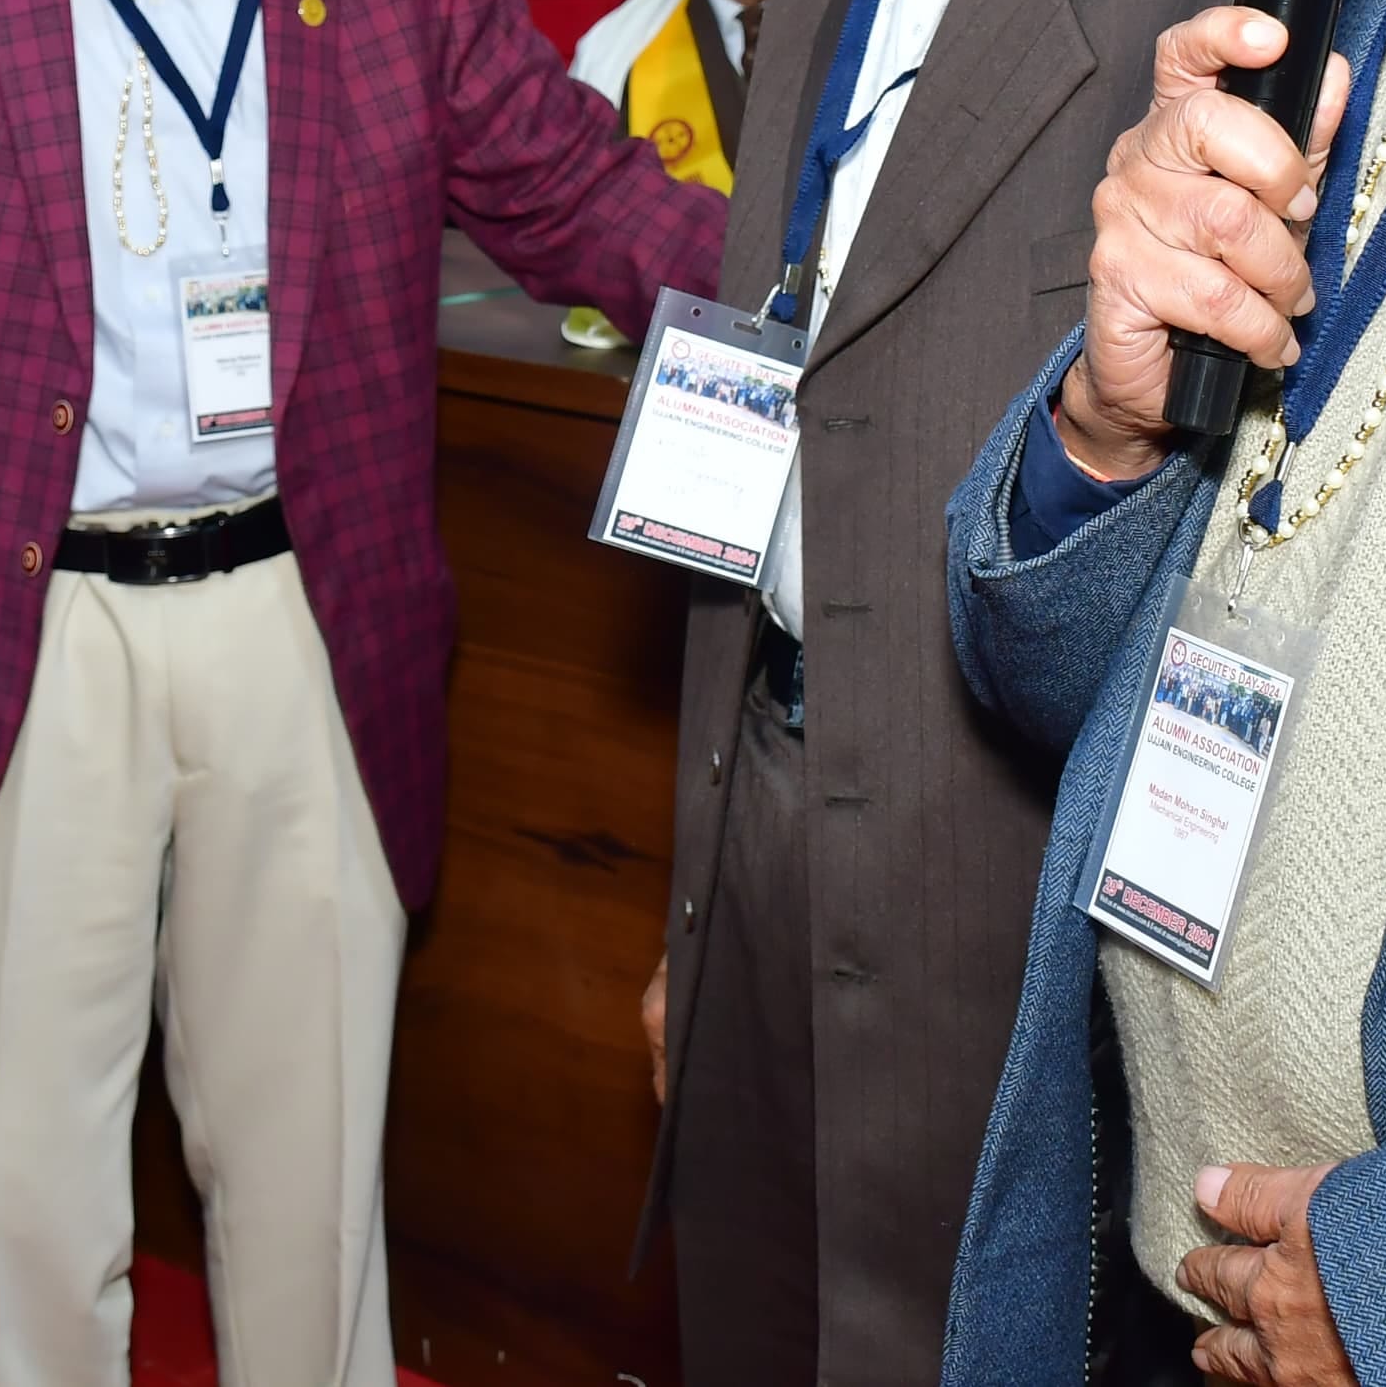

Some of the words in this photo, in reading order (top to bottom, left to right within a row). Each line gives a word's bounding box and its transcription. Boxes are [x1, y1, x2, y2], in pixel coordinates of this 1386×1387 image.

[656, 395, 704, 415] ALUMNI
[707, 410, 788, 443] ASSOCIATION
[1190, 651, 1237, 681] GECUITE'S
[1238, 671, 1281, 698] DAY-2024
[1147, 732, 1172, 752] UJJAIN
[1173, 744, 1221, 775] ENGINEERING
[1222, 767, 1256, 792] COLLEGE
[1152, 715, 1191, 744] ALUMNI
[1191, 733, 1261, 776] ASSOCIATION
[1148, 782, 1173, 803] Madan
[1175, 794, 1199, 816] Mohan
[1200, 808, 1230, 831] Singhal
[1121, 885, 1188, 936] DECEMBER
[1185, 921, 1215, 952] 2024
